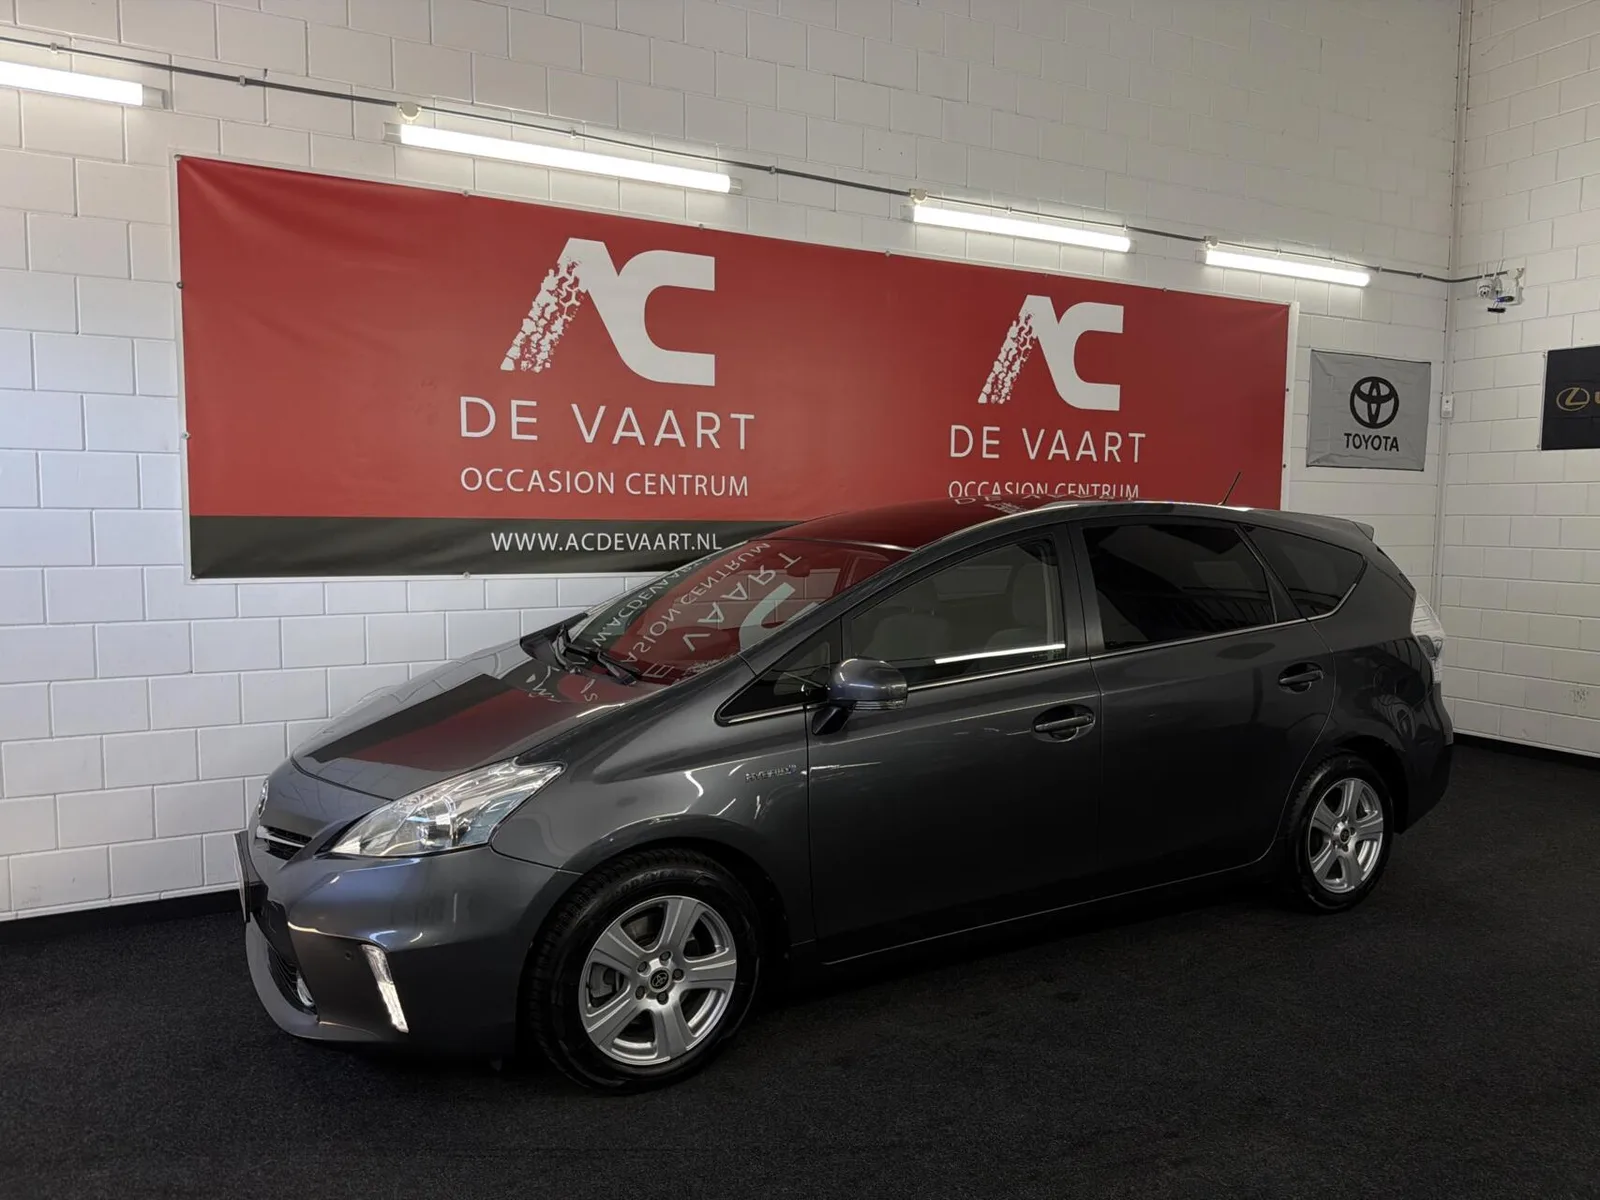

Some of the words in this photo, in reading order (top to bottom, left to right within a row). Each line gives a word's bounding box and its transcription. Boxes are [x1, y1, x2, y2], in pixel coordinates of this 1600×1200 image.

[500, 237, 715, 387] AC
[977, 294, 1125, 412] AC
[459, 396, 538, 441] DE
[571, 403, 755, 450] VAART
[950, 424, 1001, 459] DE
[1021, 427, 1146, 463] VAART
[1343, 432, 1400, 452] TOYOTA
[460, 467, 615, 495] OCCASION
[625, 472, 749, 497] CENTRUM
[948, 480, 1048, 497] OCCASION
[490, 531, 722, 552] WWW.ACDEVAART.NL
